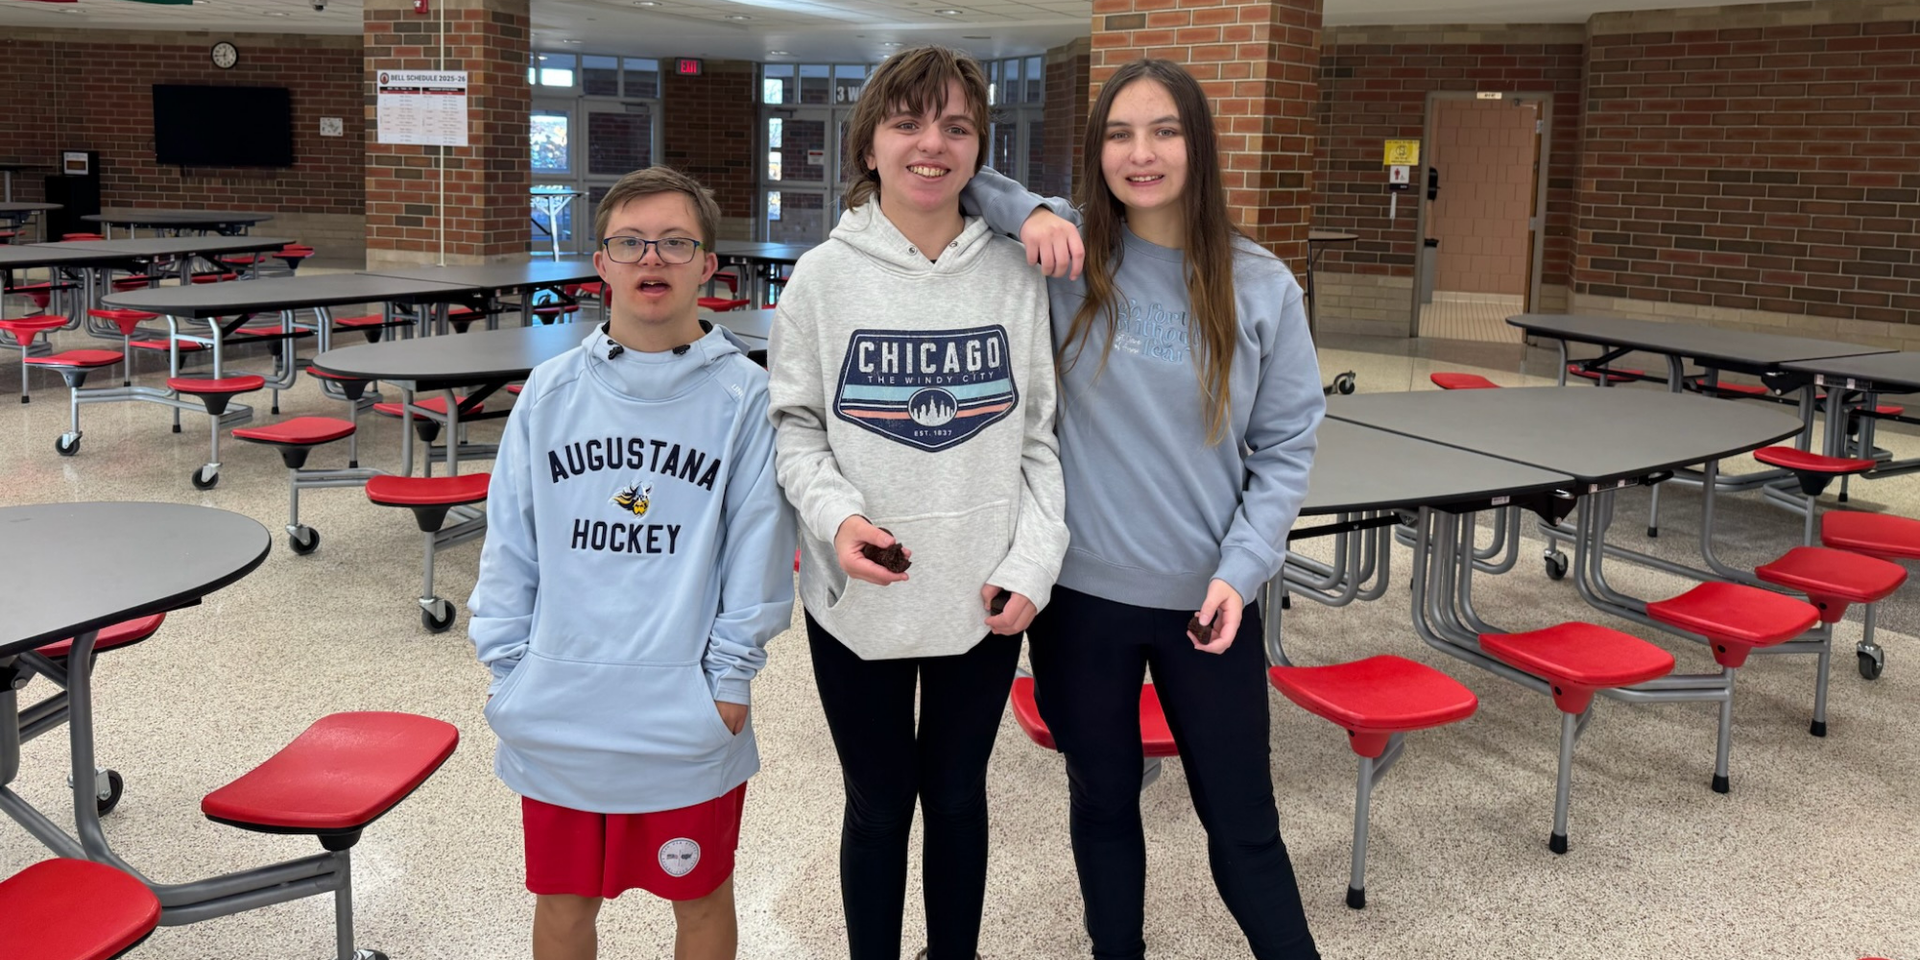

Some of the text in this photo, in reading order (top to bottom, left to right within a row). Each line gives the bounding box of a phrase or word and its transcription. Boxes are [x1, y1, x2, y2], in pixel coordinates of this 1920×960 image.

[680, 60, 698, 73] EXIT
[837, 86, 845, 102] 3
[1147, 303, 1187, 326] fort
[858, 337, 1001, 374] CHICAGO
[868, 371, 994, 384] THE WINDY CITY
[548, 436, 721, 491] AUGUSTANA
[571, 518, 681, 554] HOCKEY
